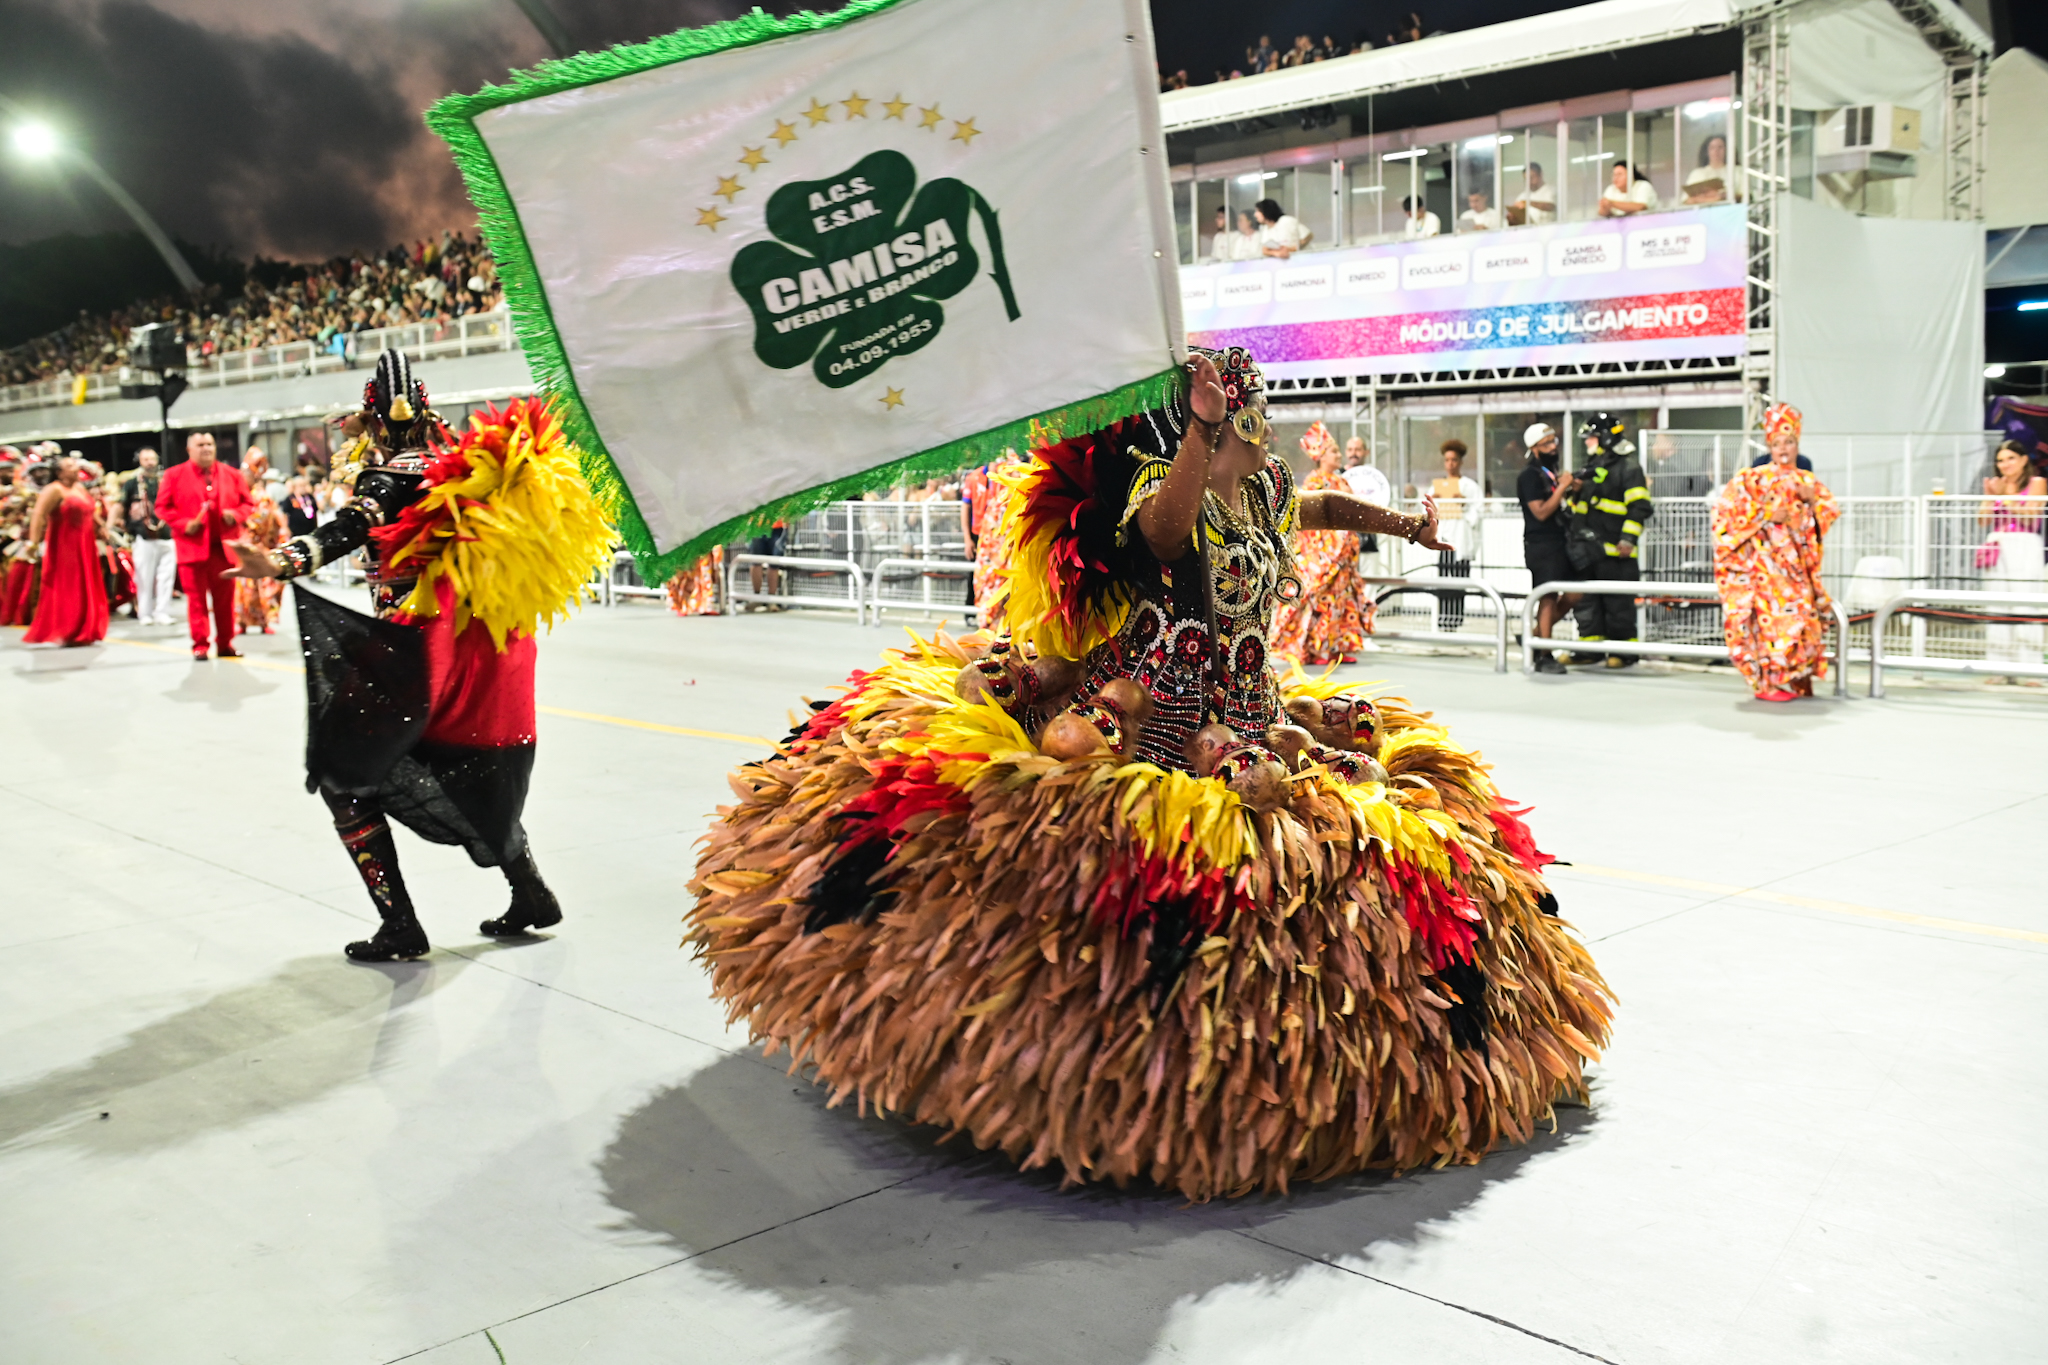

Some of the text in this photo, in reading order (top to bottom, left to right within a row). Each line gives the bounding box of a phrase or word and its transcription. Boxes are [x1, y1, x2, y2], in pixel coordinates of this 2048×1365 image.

[808, 176, 876, 211] A.C.S.
[812, 199, 883, 234] E.S.M.
[1562, 254, 1607, 266] ENREDO
[1565, 245, 1603, 255] SAMBA
[760, 217, 958, 315] CAMISA
[1409, 262, 1463, 277] EVOLUÇÃO
[1486, 257, 1529, 269] BATERIA
[1224, 284, 1263, 295] FANTASIA
[1281, 278, 1327, 288] HARMONIA
[1348, 271, 1386, 283] ENREDO
[772, 297, 853, 334] VERDE
[866, 250, 959, 303] BRANCO
[839, 313, 916, 354] FUNDADA EM
[1400, 302, 1709, 344] MÓDULO DE JULGAMENTO
[828, 318, 933, 376] 04.09.1953
